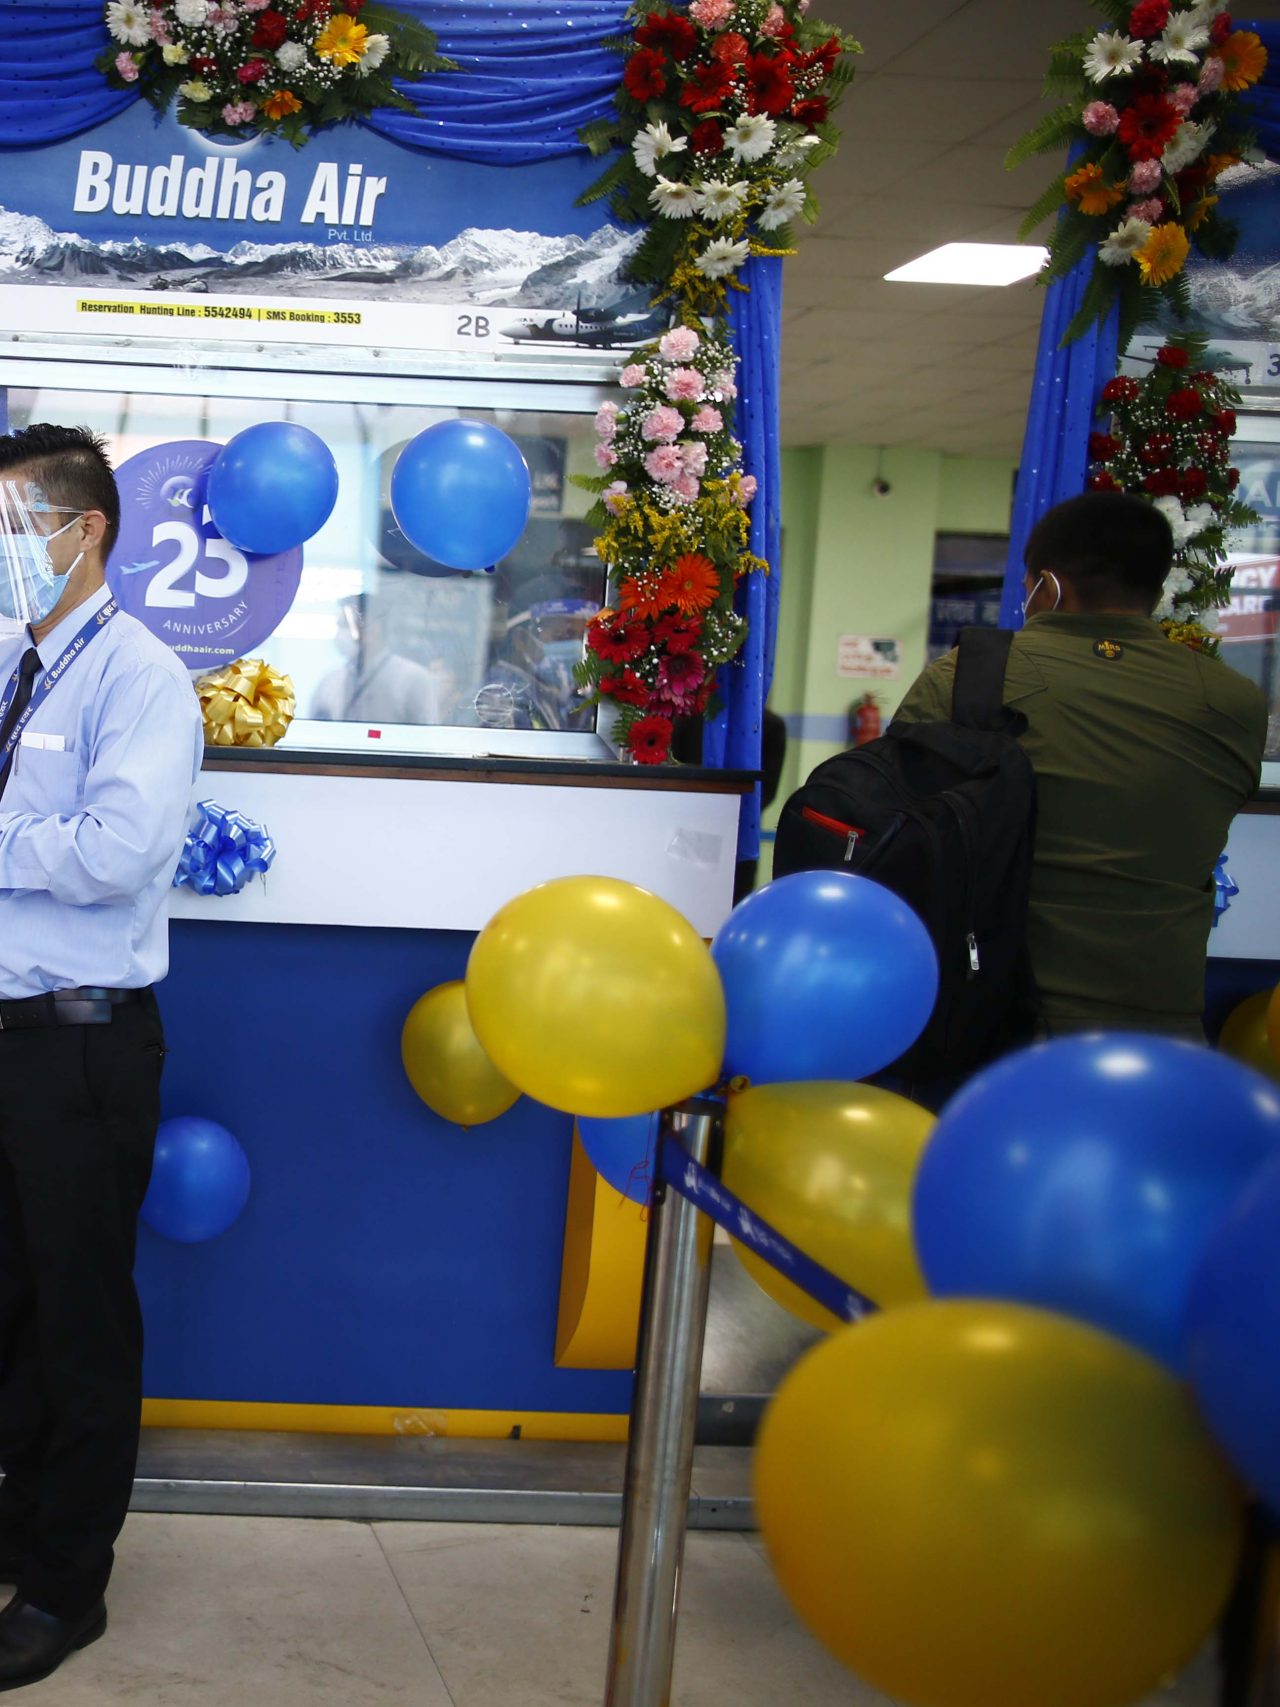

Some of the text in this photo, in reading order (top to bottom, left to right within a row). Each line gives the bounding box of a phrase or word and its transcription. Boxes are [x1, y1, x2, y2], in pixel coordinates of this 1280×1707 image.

[73, 150, 387, 226] Buddha Air
[327, 228, 375, 242] Pvt. Ltd.
[81, 302, 135, 314] Reservation
[139, 304, 174, 317] Hunting
[176, 308, 196, 317] Line
[204, 305, 253, 319] 5542494
[266, 310, 286, 321] SMS
[289, 311, 325, 323] Booking
[333, 311, 361, 324] 3553
[457, 314, 490, 338] 2B
[163, 601, 248, 635] ANNIVERSARY
[51, 637, 85, 679] Buddha Air
[169, 644, 235, 655] uddhaair.com
